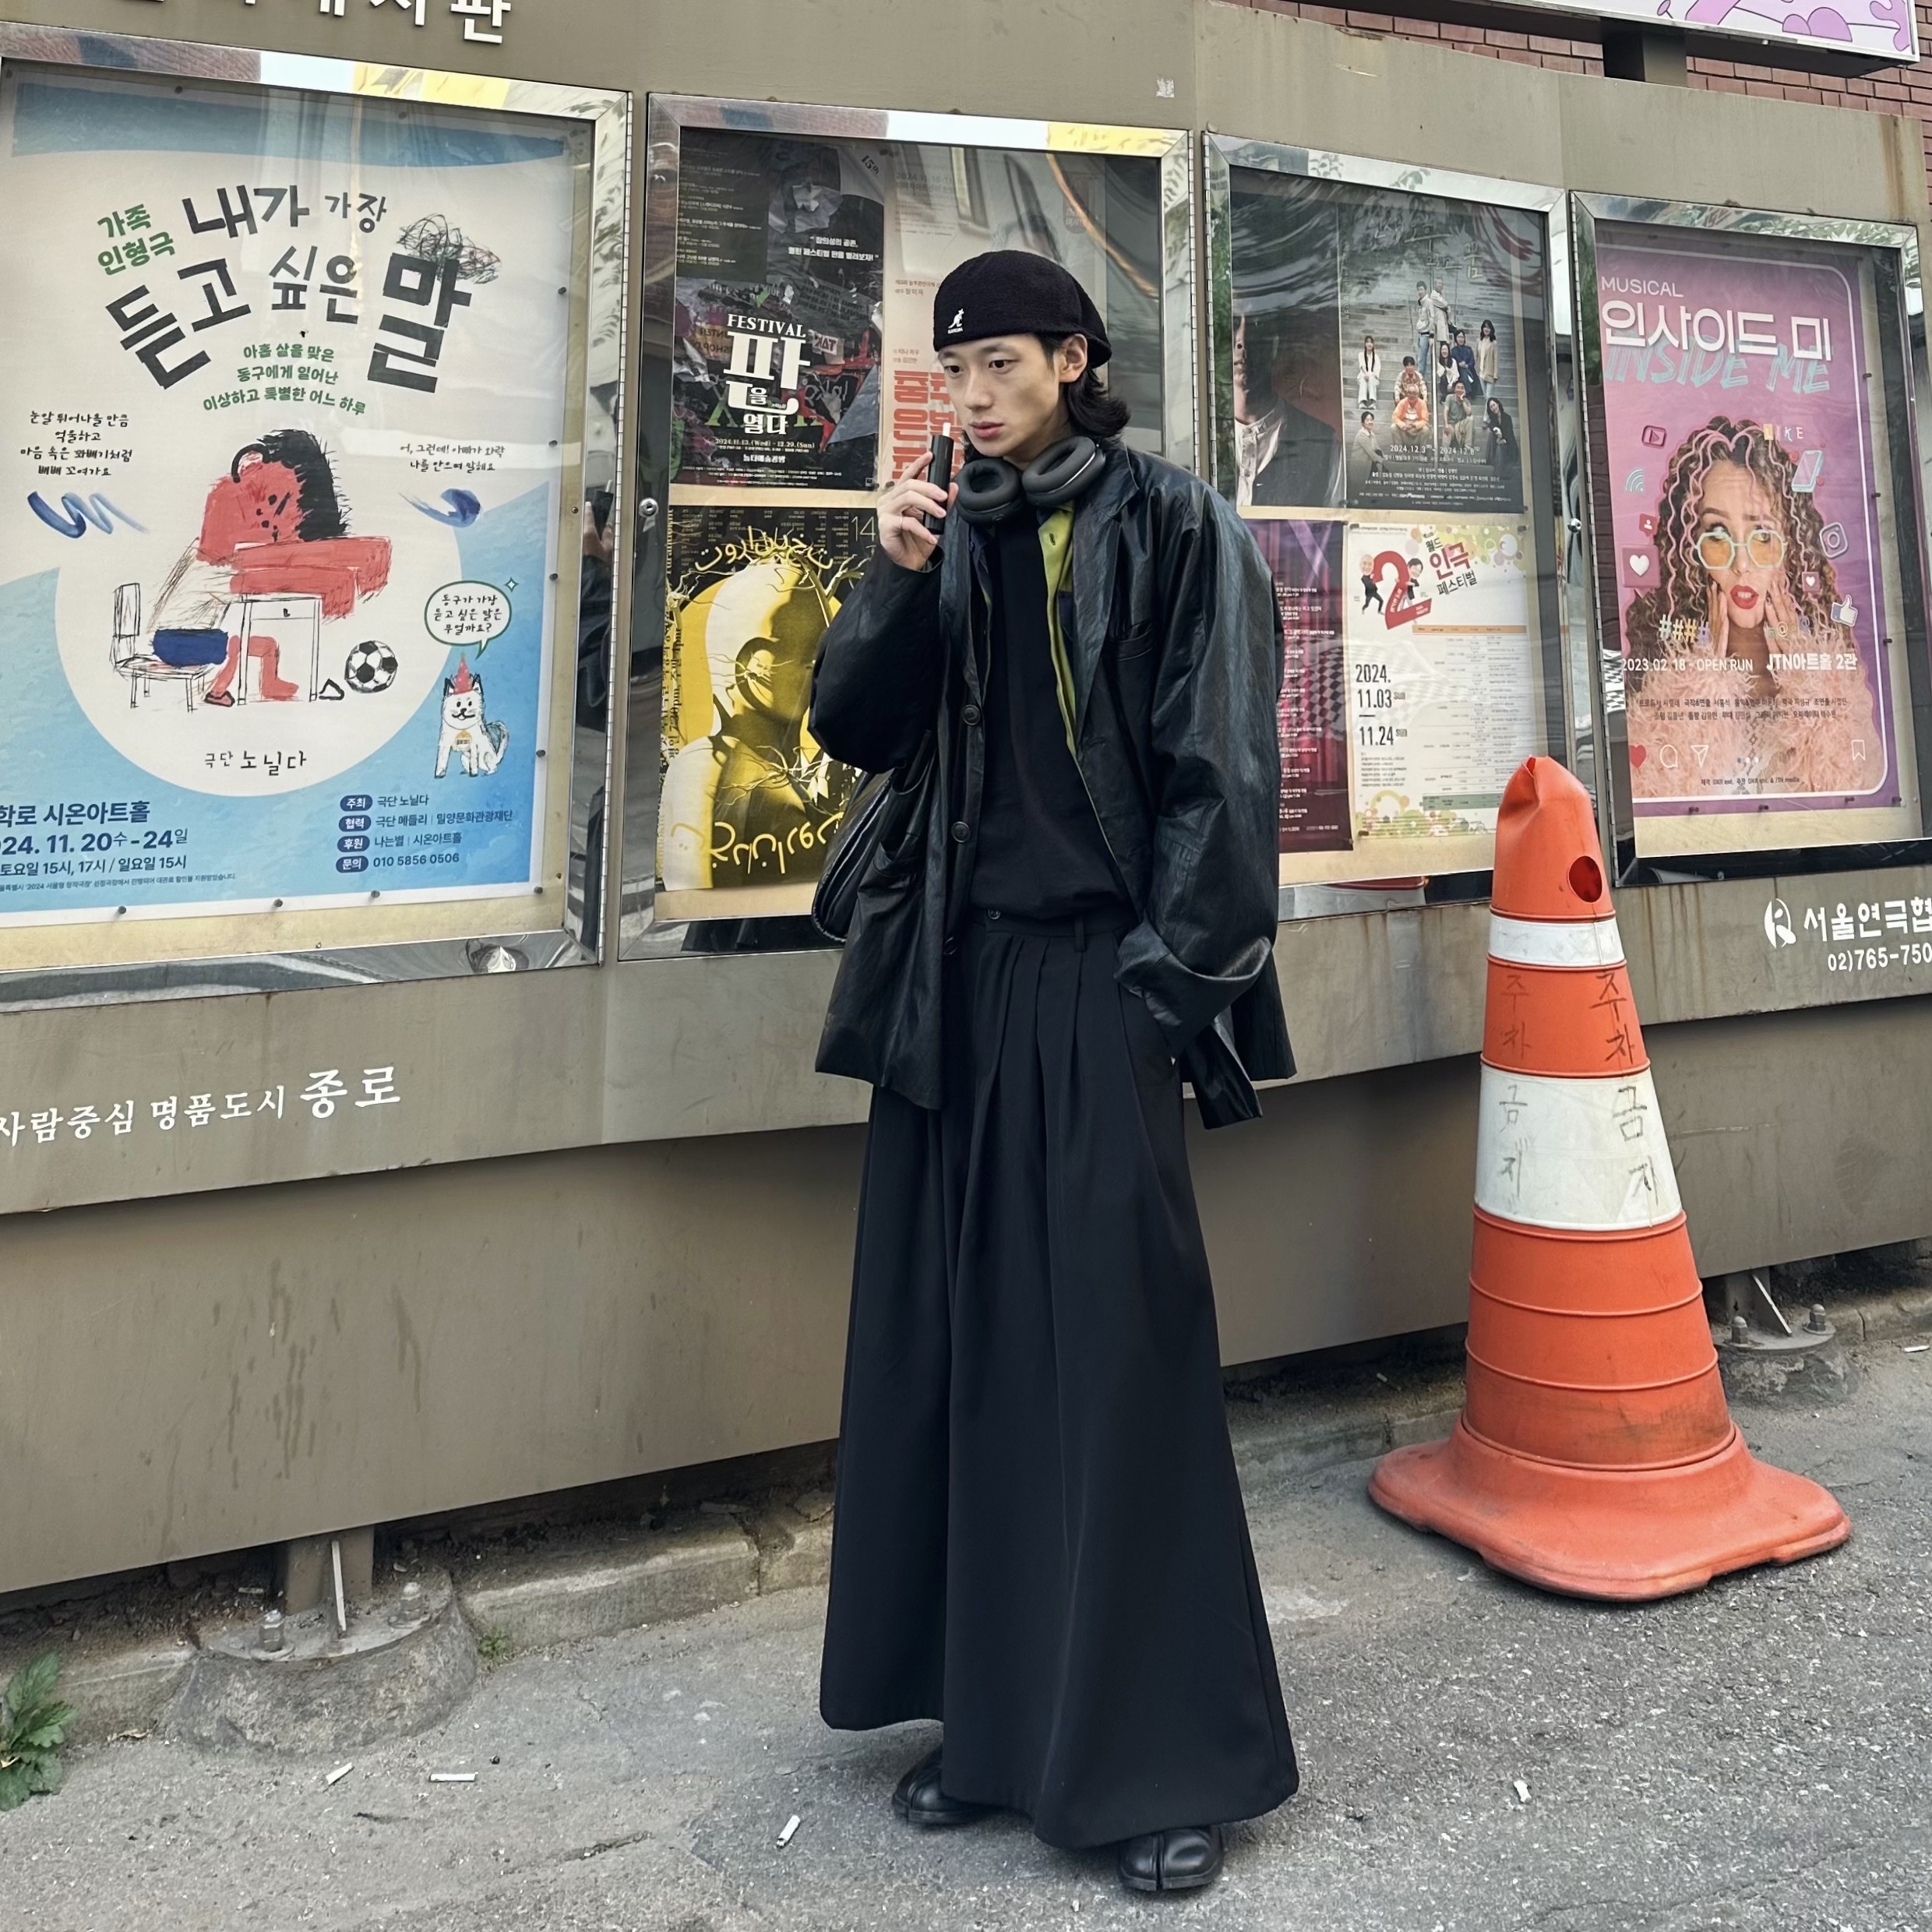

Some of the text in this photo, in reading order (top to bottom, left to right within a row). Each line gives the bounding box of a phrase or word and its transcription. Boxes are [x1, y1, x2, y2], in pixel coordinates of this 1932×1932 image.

[97, 204, 151, 238] 가족
[182, 185, 388, 238] 내가 가장
[97, 231, 175, 277] 인형극
[1601, 277, 1683, 298] MUSICAL
[105, 245, 473, 393] 듣고 싶은 말
[727, 314, 806, 338] FESTIVAL
[1601, 300, 1832, 361] 인사이드 미
[243, 343, 335, 363] 아홉 살을 맞은
[1605, 335, 1831, 394] INSIDE ME
[237, 365, 339, 385] 동구에게 일어난
[203, 386, 366, 416] 이상하고 특별한 어느 하루
[30, 411, 55, 425] 눈알
[107, 414, 129, 428] 만큼
[743, 414, 788, 435] 열다
[55, 429, 101, 443] 억울하고
[1763, 423, 1804, 442] LIKE
[20, 446, 43, 460] 마음
[48, 446, 70, 460] 속은
[485, 446, 506, 458] 와락
[65, 466, 111, 476] 꼬여가요
[410, 460, 495, 474] 나를 안으며 말해요
[851, 516, 876, 542] 14
[1426, 538, 1443, 552] 월드
[1430, 542, 1470, 580] 인극
[1437, 570, 1477, 595] 페스티벌
[442, 594, 498, 606] 동구가 가장
[434, 608, 502, 621] 듣고 싶은 말은
[444, 623, 492, 636] 무얼까요?
[1696, 659, 1728, 672] OPEN
[1729, 658, 1754, 672] RUN
[1766, 654, 1832, 672] JTN아트홀
[1836, 653, 1858, 671] 2관
[1356, 664, 1391, 683] 2024.
[1358, 689, 1392, 708] 11.03
[1359, 726, 1394, 746] 11.24
[204, 750, 307, 776] 극단 노닐다
[347, 794, 429, 809] 주최 극단 노닐다
[43, 800, 150, 826] 시온아트홀
[345, 818, 365, 829] 협력
[375, 816, 396, 827] 극단
[437, 810, 513, 825] 밀양문화관광재단
[0, 835, 40, 855] 24.
[344, 832, 462, 849] 후원 나는별 시온아트홀
[0, 861, 38, 876] 토요일
[43, 861, 75, 876] 15시,
[78, 859, 106, 873] 17시
[118, 857, 156, 872] 일요일
[159, 855, 187, 869] 15시
[342, 853, 460, 870] 문의 010 5856 0506
[1589, 972, 1635, 1065] 주차
[0, 1066, 400, 1146] 사람중심 명품도시 종로
